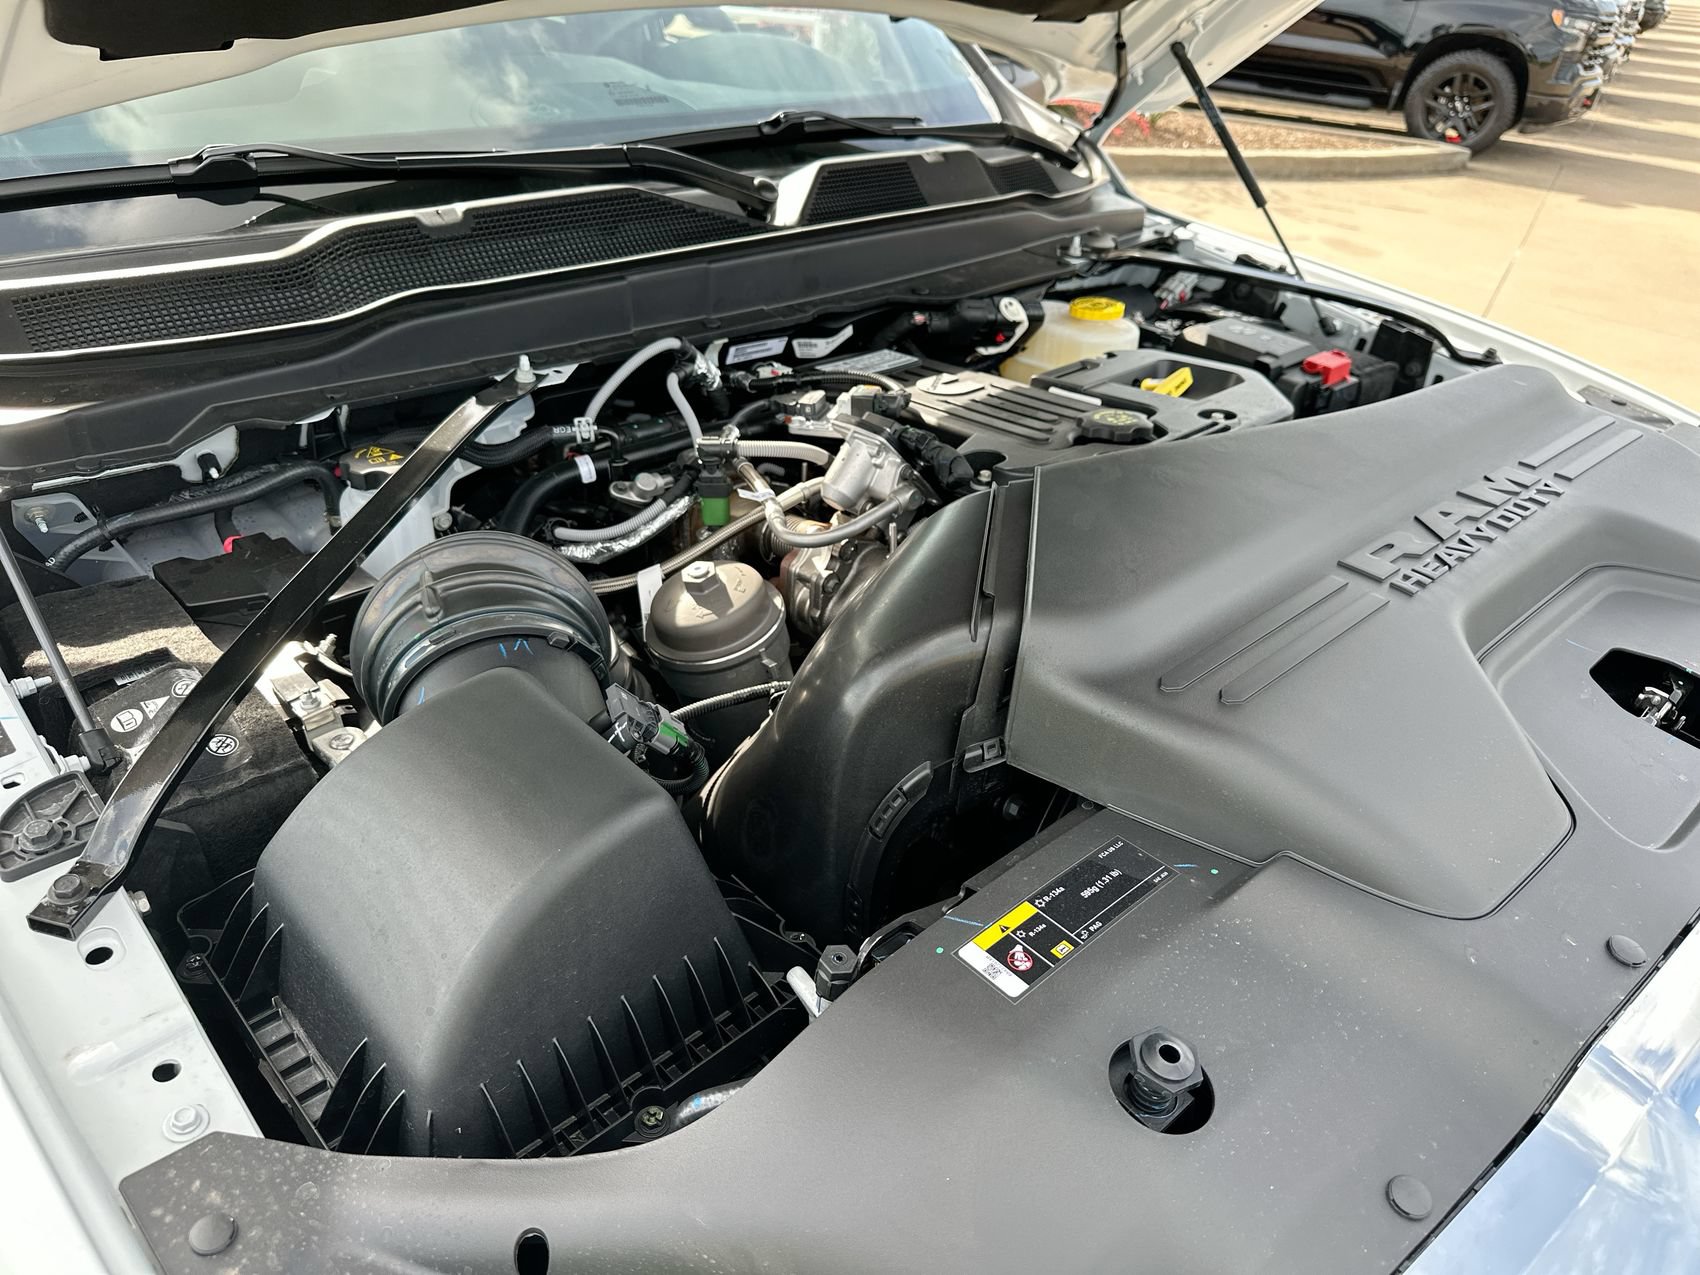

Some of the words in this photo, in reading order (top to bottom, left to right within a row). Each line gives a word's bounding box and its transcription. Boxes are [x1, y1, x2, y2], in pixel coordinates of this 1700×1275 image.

[1337, 466, 1541, 583] RAM
[1389, 523, 1498, 597] HEAVY
[1486, 480, 1565, 532] DUTY
[1098, 850, 1109, 859] FCA
[1113, 841, 1124, 849] LLC
[1080, 885, 1100, 899] 595g
[1095, 874, 1113, 889] (1.31
[1109, 868, 1123, 878] lb)
[1043, 886, 1066, 902] R-134a
[1028, 923, 1047, 937] R-134a
[1089, 920, 1103, 932] PAG
